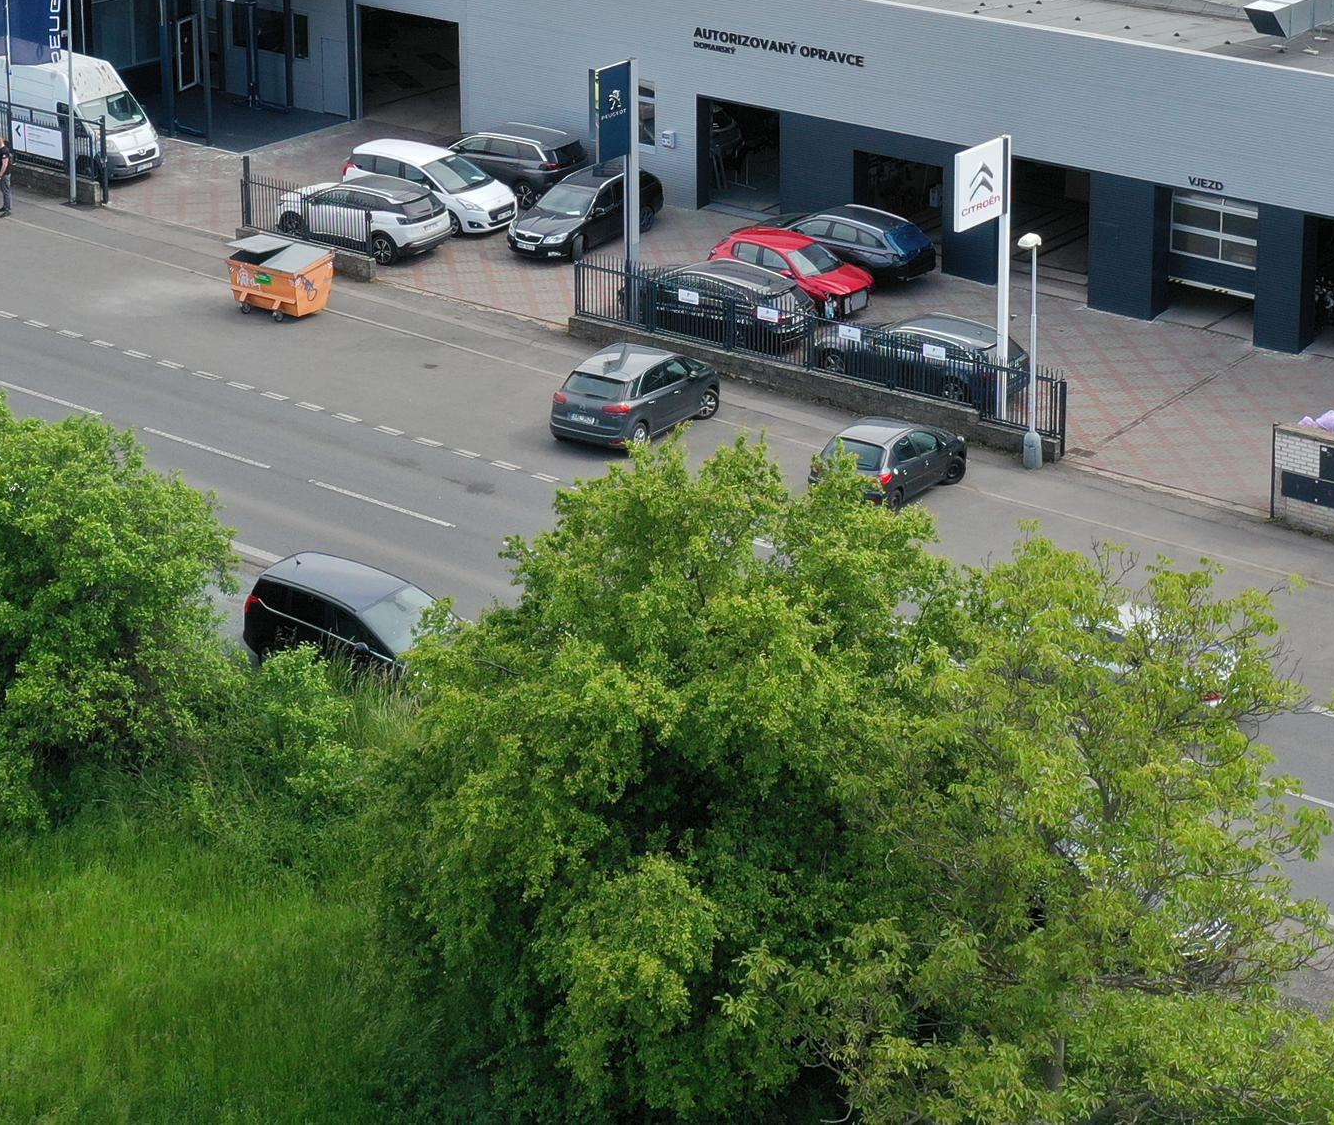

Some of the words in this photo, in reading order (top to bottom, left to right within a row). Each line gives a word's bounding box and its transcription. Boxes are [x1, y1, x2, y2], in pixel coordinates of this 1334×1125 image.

[693, 27, 797, 55] AUTORIZOVANÝ
[799, 45, 865, 67] OPRAVCE
[1188, 175, 1224, 191] VJEZD
